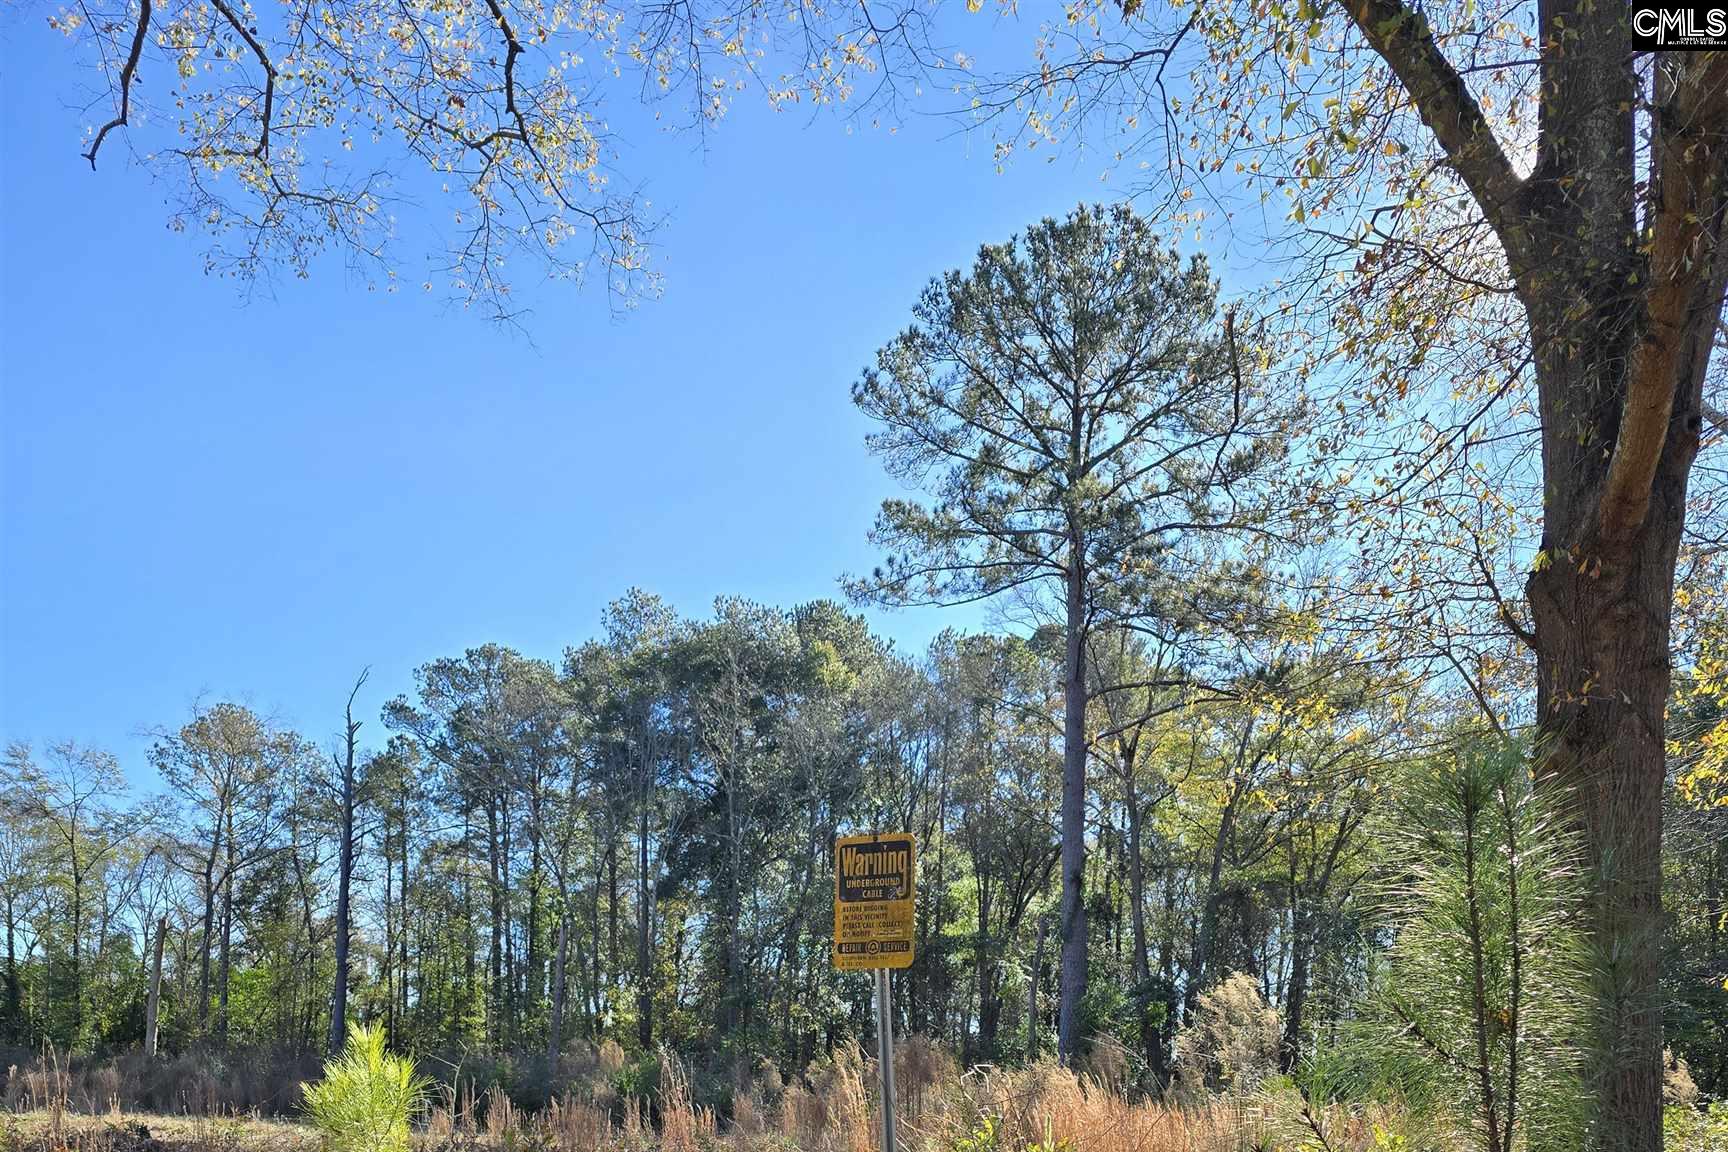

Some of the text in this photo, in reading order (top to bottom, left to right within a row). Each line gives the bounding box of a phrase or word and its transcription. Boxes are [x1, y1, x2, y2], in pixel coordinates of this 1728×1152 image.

[842, 845, 907, 896] Warning
[846, 877, 900, 888] UNDERGROUND
[862, 890, 882, 898] CABLE
